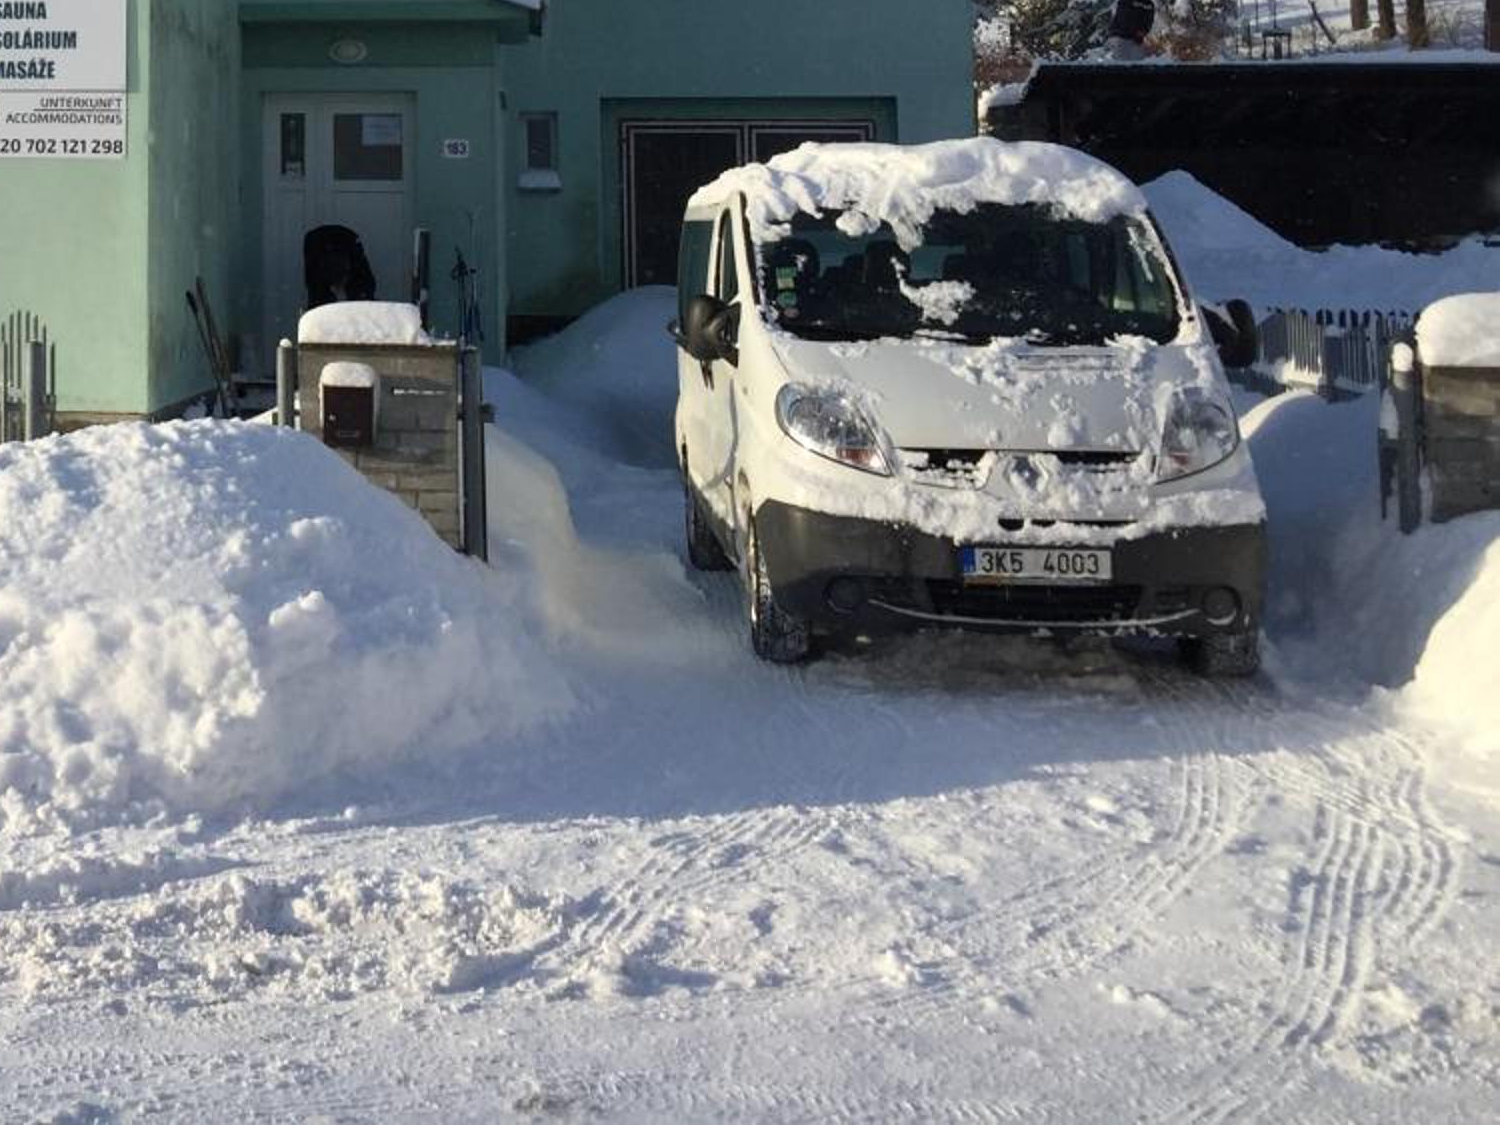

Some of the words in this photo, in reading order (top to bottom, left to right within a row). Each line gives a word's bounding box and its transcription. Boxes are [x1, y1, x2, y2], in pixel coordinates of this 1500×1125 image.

[40, 97, 123, 108] UNTERKUNFT
[5, 112, 123, 124] ACCOMMODATIONS
[26, 139, 57, 154] 702
[61, 139, 87, 154] 121
[91, 139, 123, 154] 298
[981, 551, 1023, 573] 3K5
[1043, 553, 1099, 574] 4003
